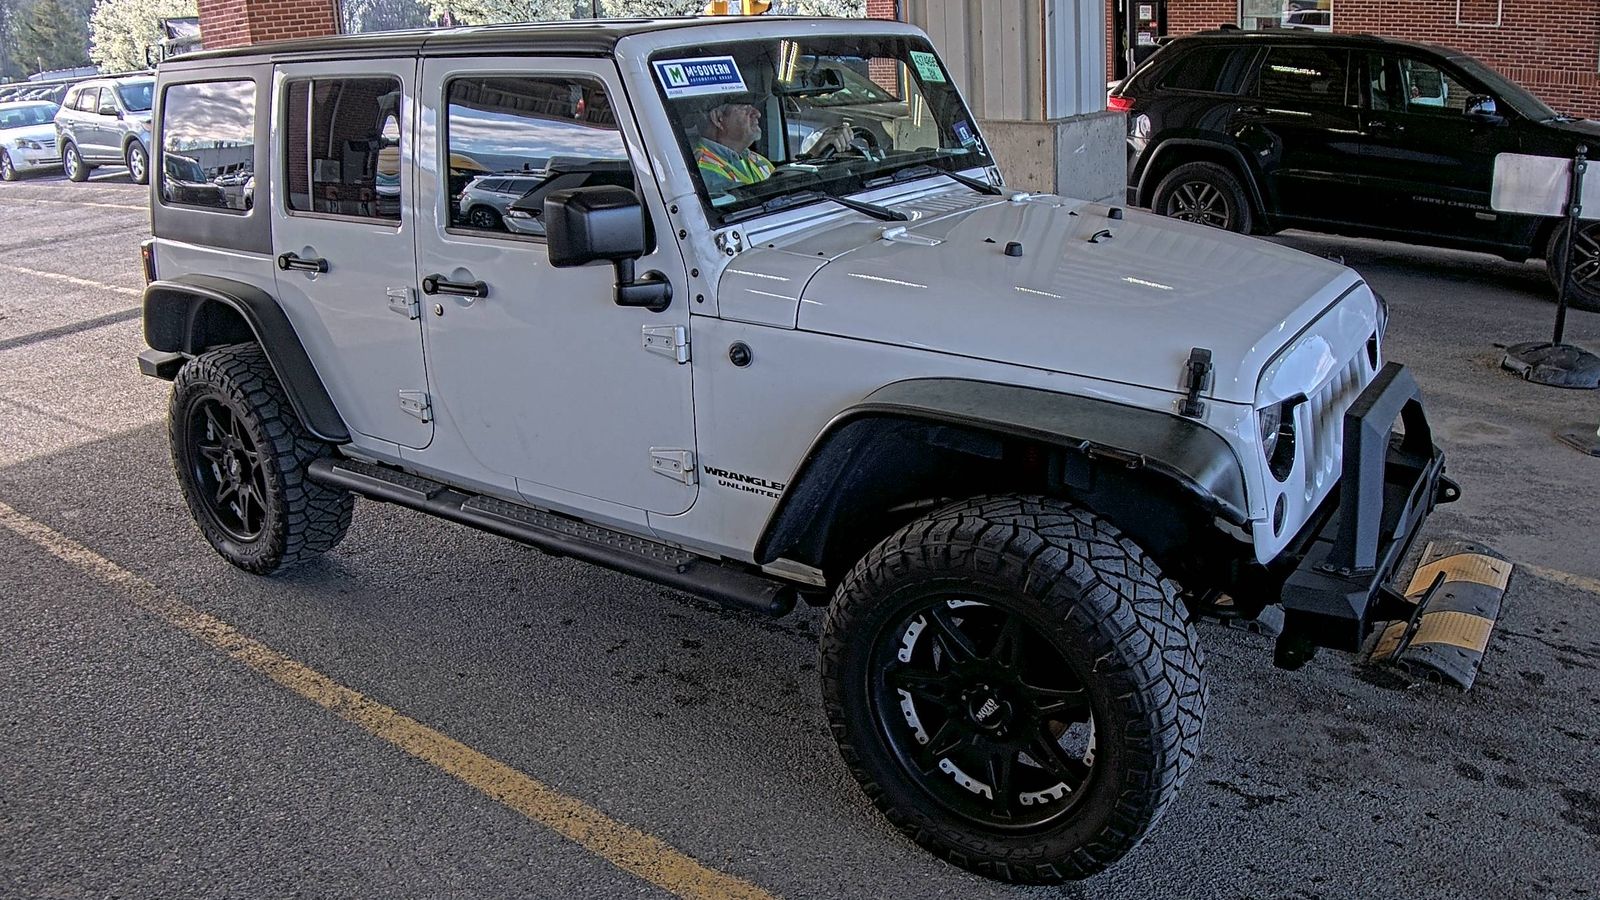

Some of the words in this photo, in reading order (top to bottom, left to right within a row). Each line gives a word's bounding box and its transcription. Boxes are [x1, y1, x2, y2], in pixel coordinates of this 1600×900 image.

[669, 67, 684, 83] M
[1447, 200, 1490, 210] CHEROKE
[976, 698, 995, 722] MOTO
